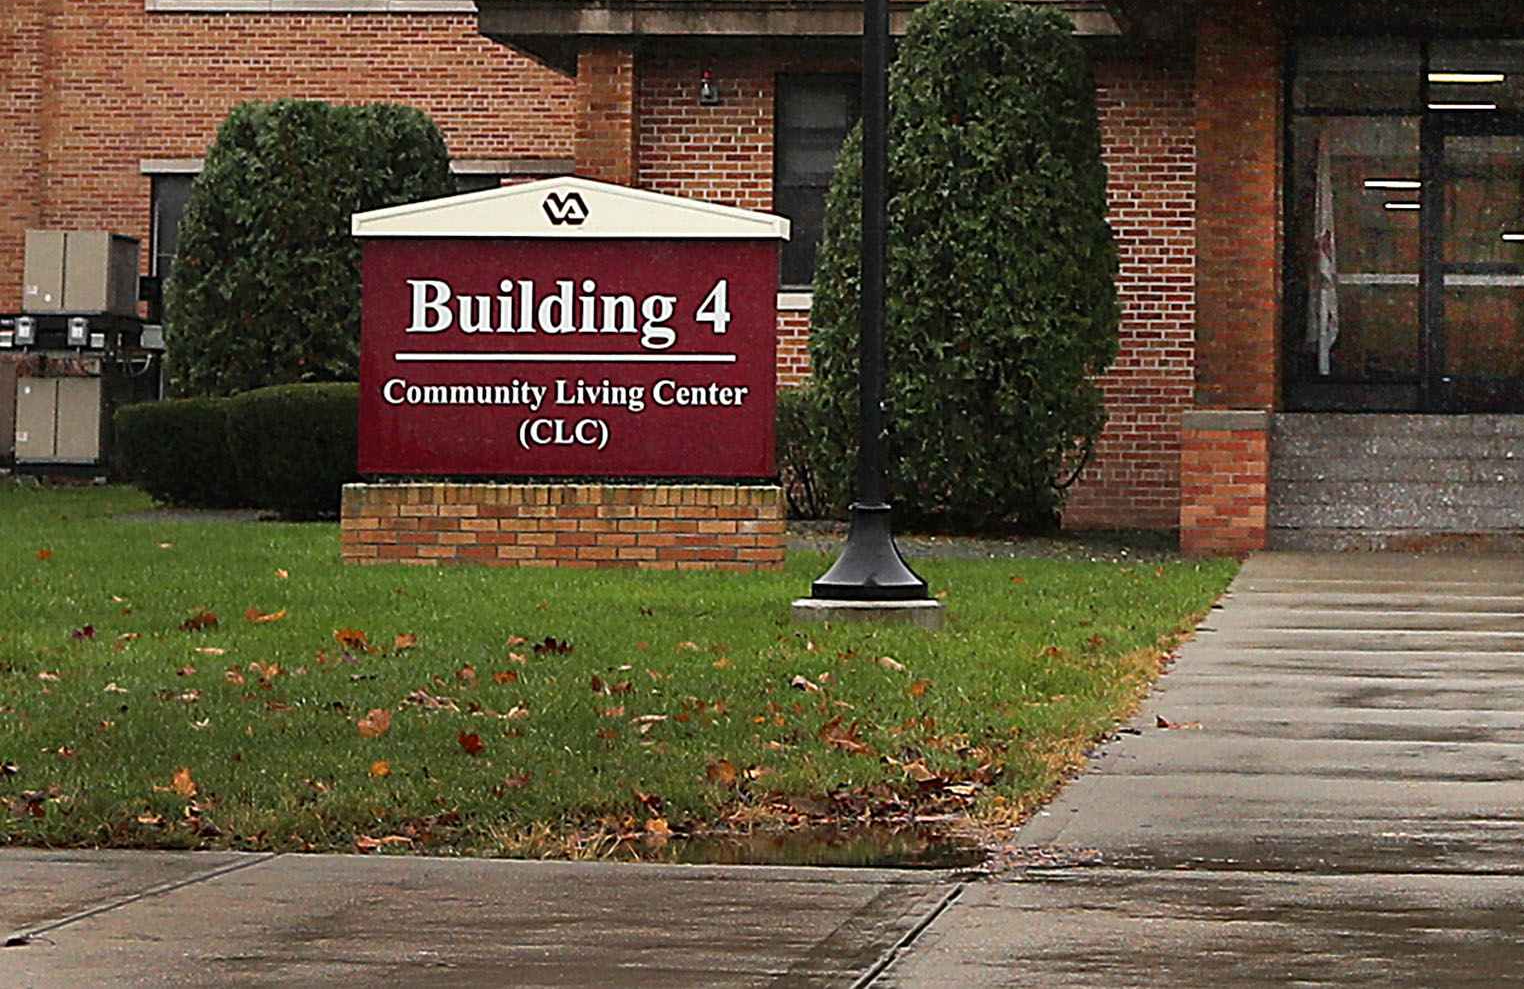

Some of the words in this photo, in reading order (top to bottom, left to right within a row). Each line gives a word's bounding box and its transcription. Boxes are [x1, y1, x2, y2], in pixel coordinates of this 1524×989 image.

[543, 192, 589, 225] VA
[405, 279, 677, 349] Building
[695, 279, 731, 333] 4
[383, 379, 547, 411] Community
[555, 380, 645, 412] Living
[652, 380, 749, 406] Center
[519, 419, 609, 450] (CLC)
